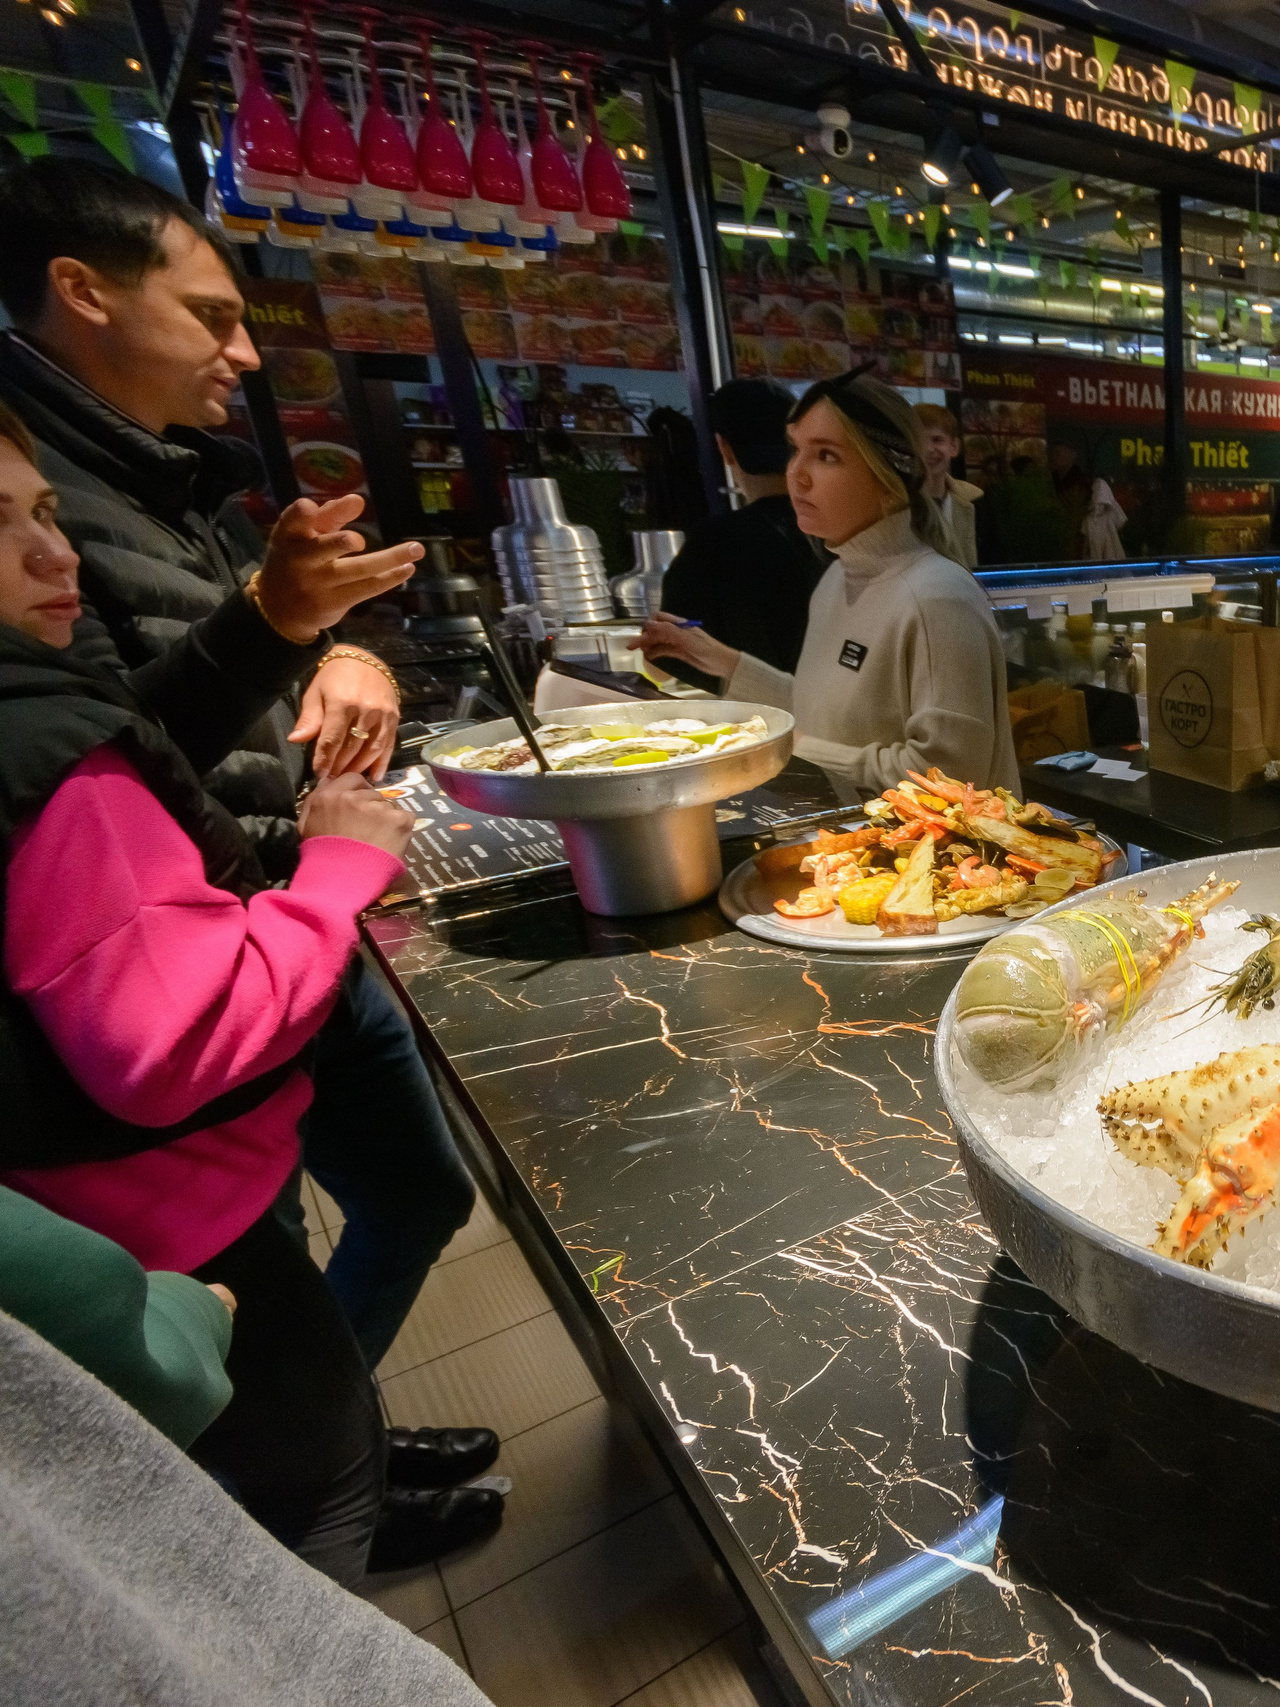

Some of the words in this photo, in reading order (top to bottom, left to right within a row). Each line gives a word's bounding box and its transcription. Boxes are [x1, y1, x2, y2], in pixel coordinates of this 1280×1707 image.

[1120, 437, 1165, 466] Pha
[1189, 440, 1249, 469] Thiết
[1164, 699, 1206, 718] ГАСТРО
[1170, 715, 1198, 734] КОРТ
